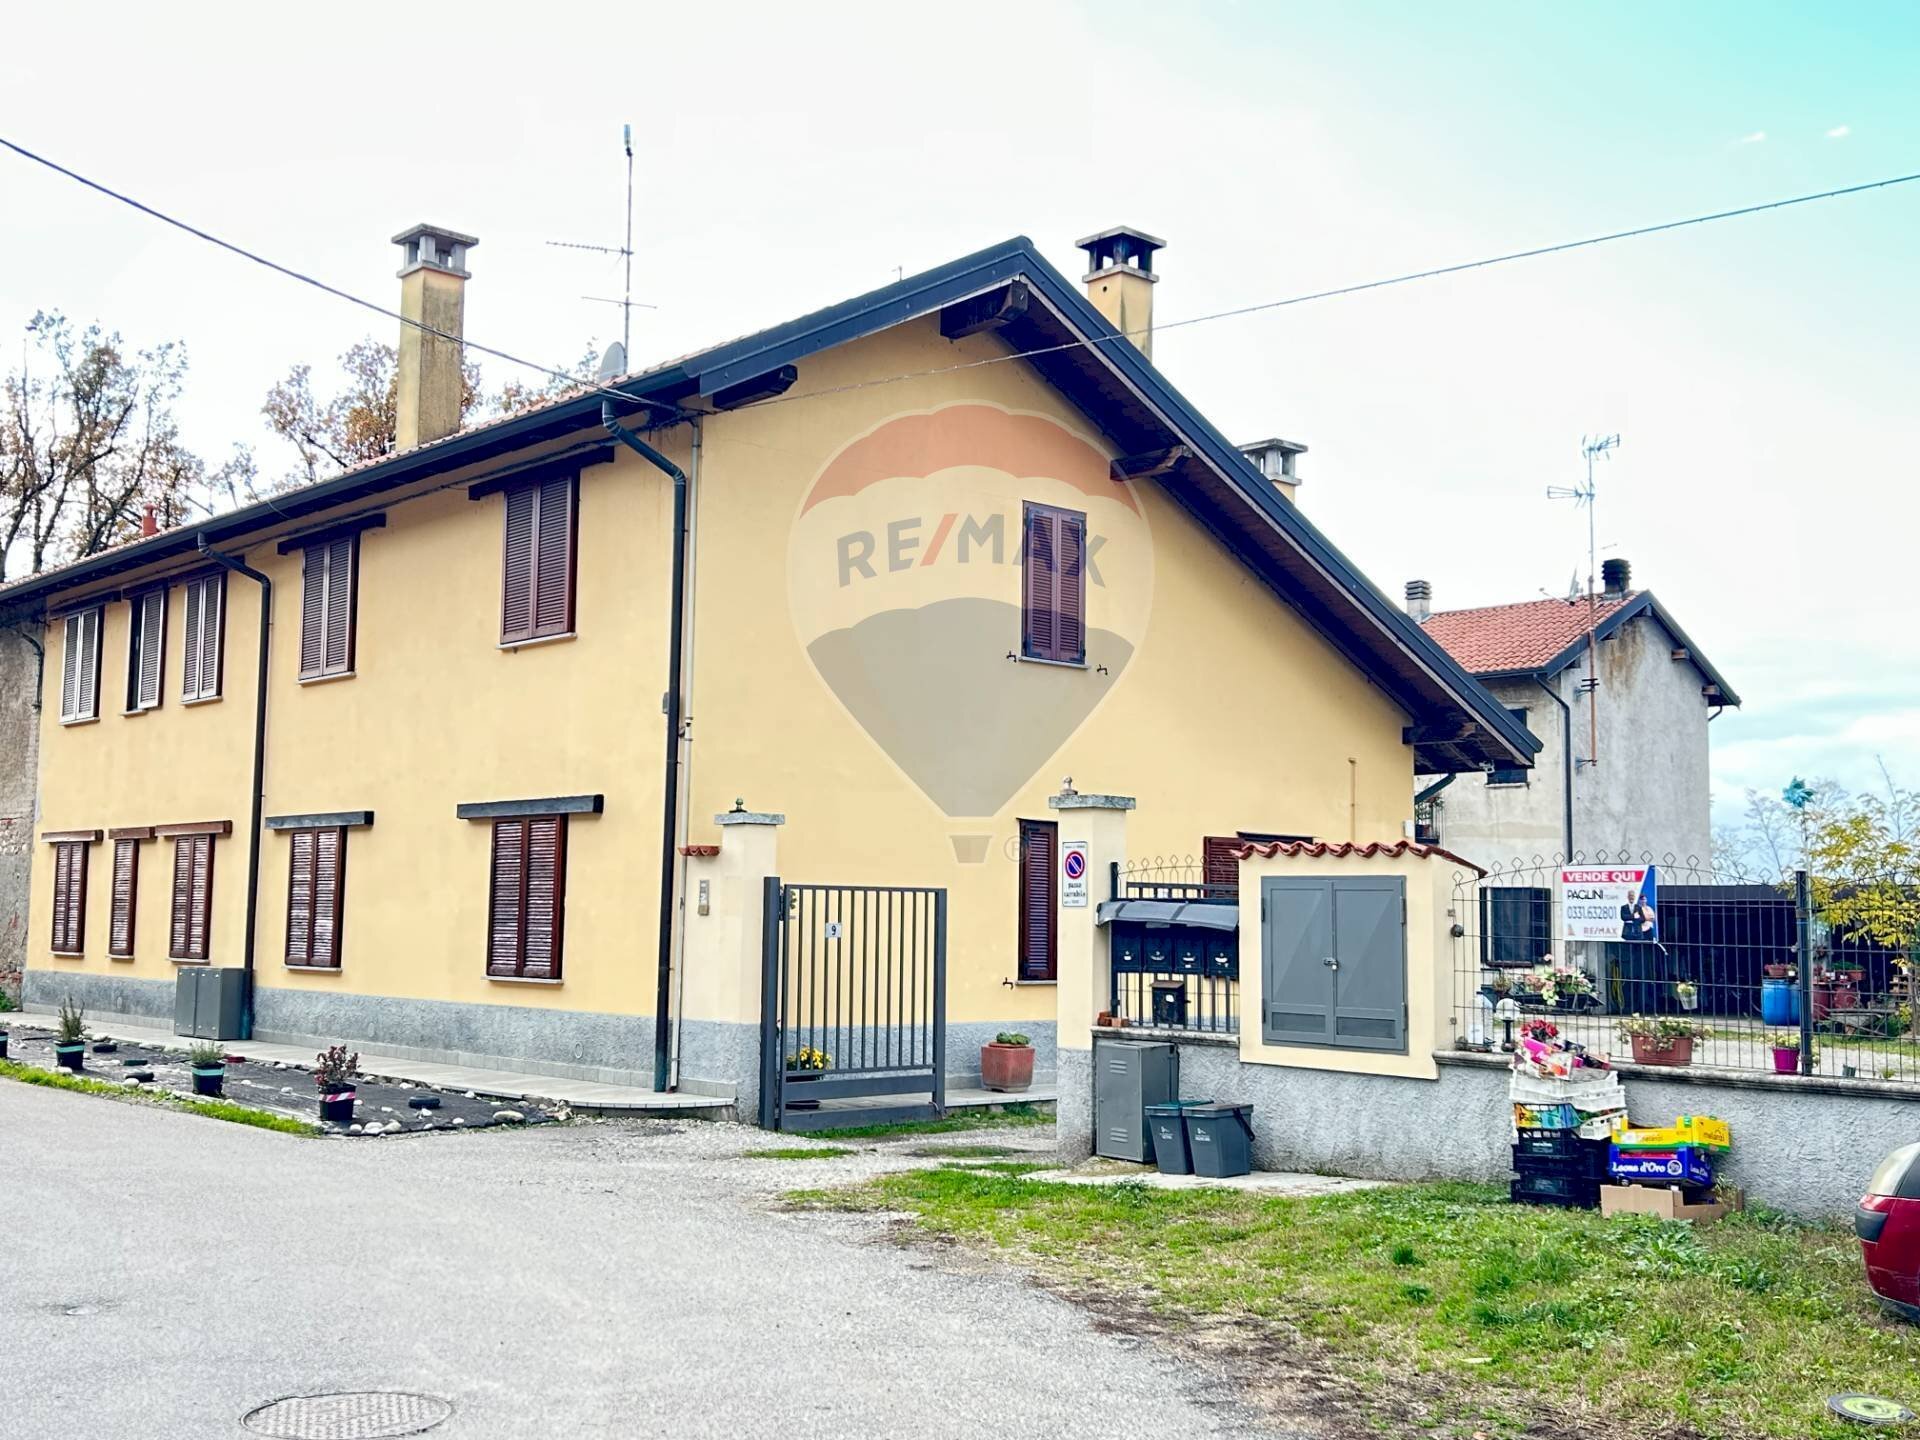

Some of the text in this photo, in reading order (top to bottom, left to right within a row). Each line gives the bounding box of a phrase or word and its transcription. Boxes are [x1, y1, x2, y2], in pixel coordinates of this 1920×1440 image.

[1566, 872, 1636, 883] VENDE QUI
[1567, 905, 1617, 919] 0331.632801
[831, 925, 837, 936] 9
[1583, 927, 1617, 935] RE/MAX
